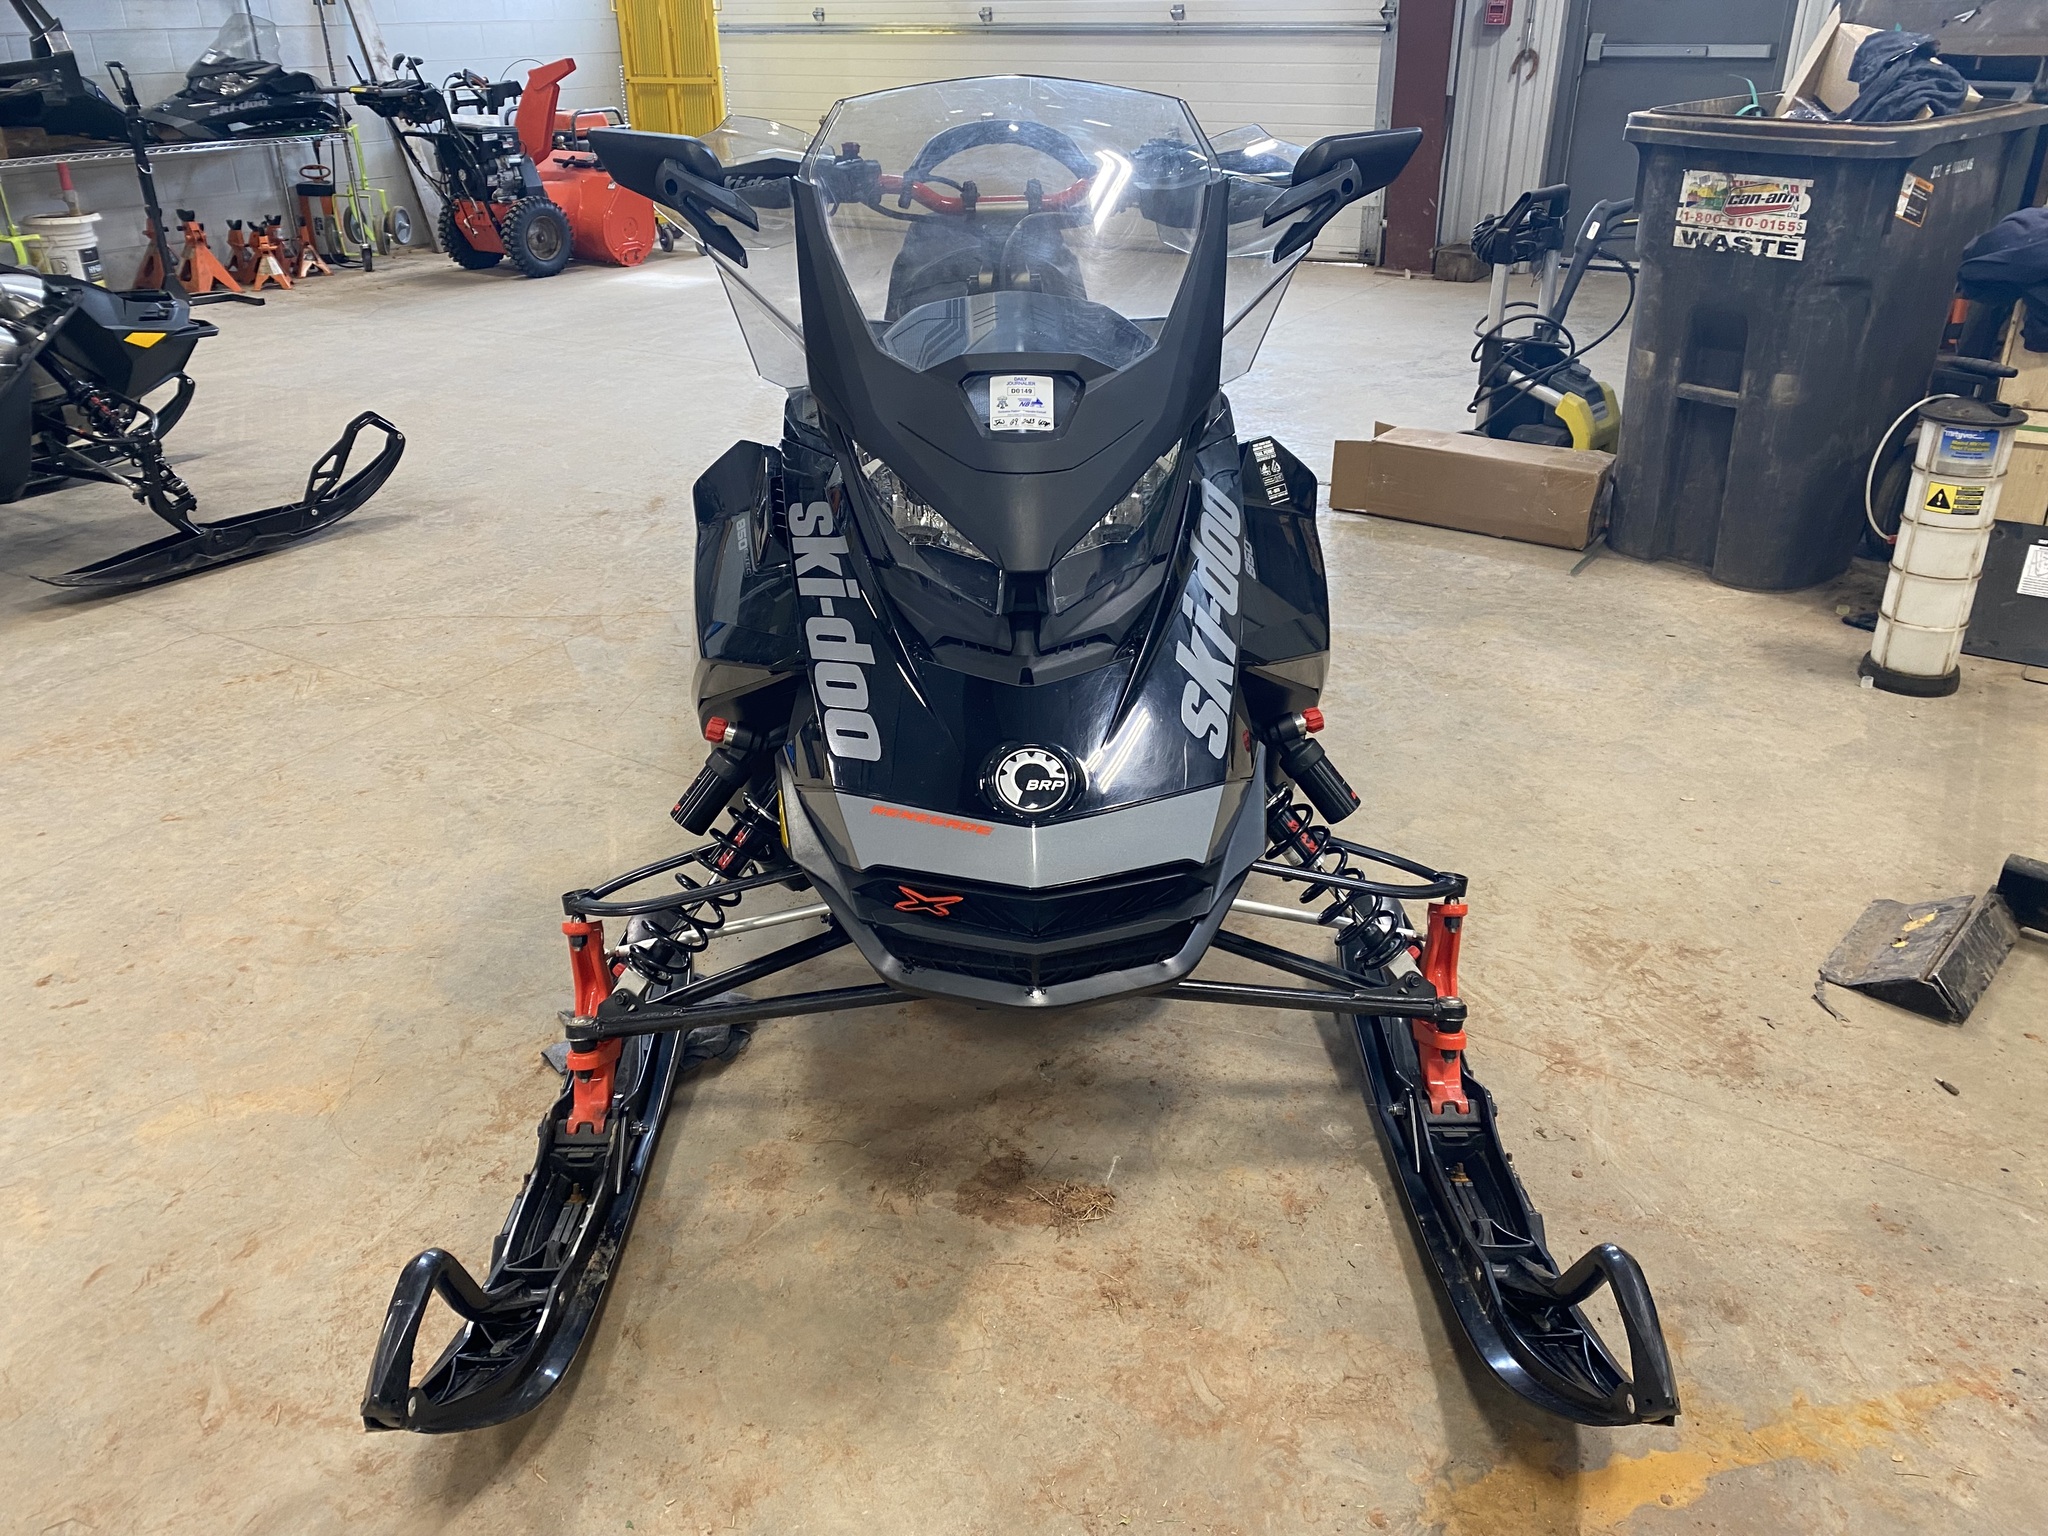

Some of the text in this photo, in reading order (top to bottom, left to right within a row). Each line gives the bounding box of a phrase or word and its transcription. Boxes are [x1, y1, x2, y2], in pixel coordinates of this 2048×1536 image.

[1727, 192, 1797, 205] can-am
[1681, 230, 1799, 257] WASTE
[736, 518, 748, 551] 850
[1243, 538, 1257, 580] 850
[788, 501, 882, 762] ski-doo
[1175, 478, 1242, 760] ski-doo
[1025, 779, 1065, 791] BRP
[869, 805, 995, 837] RENEGADE
